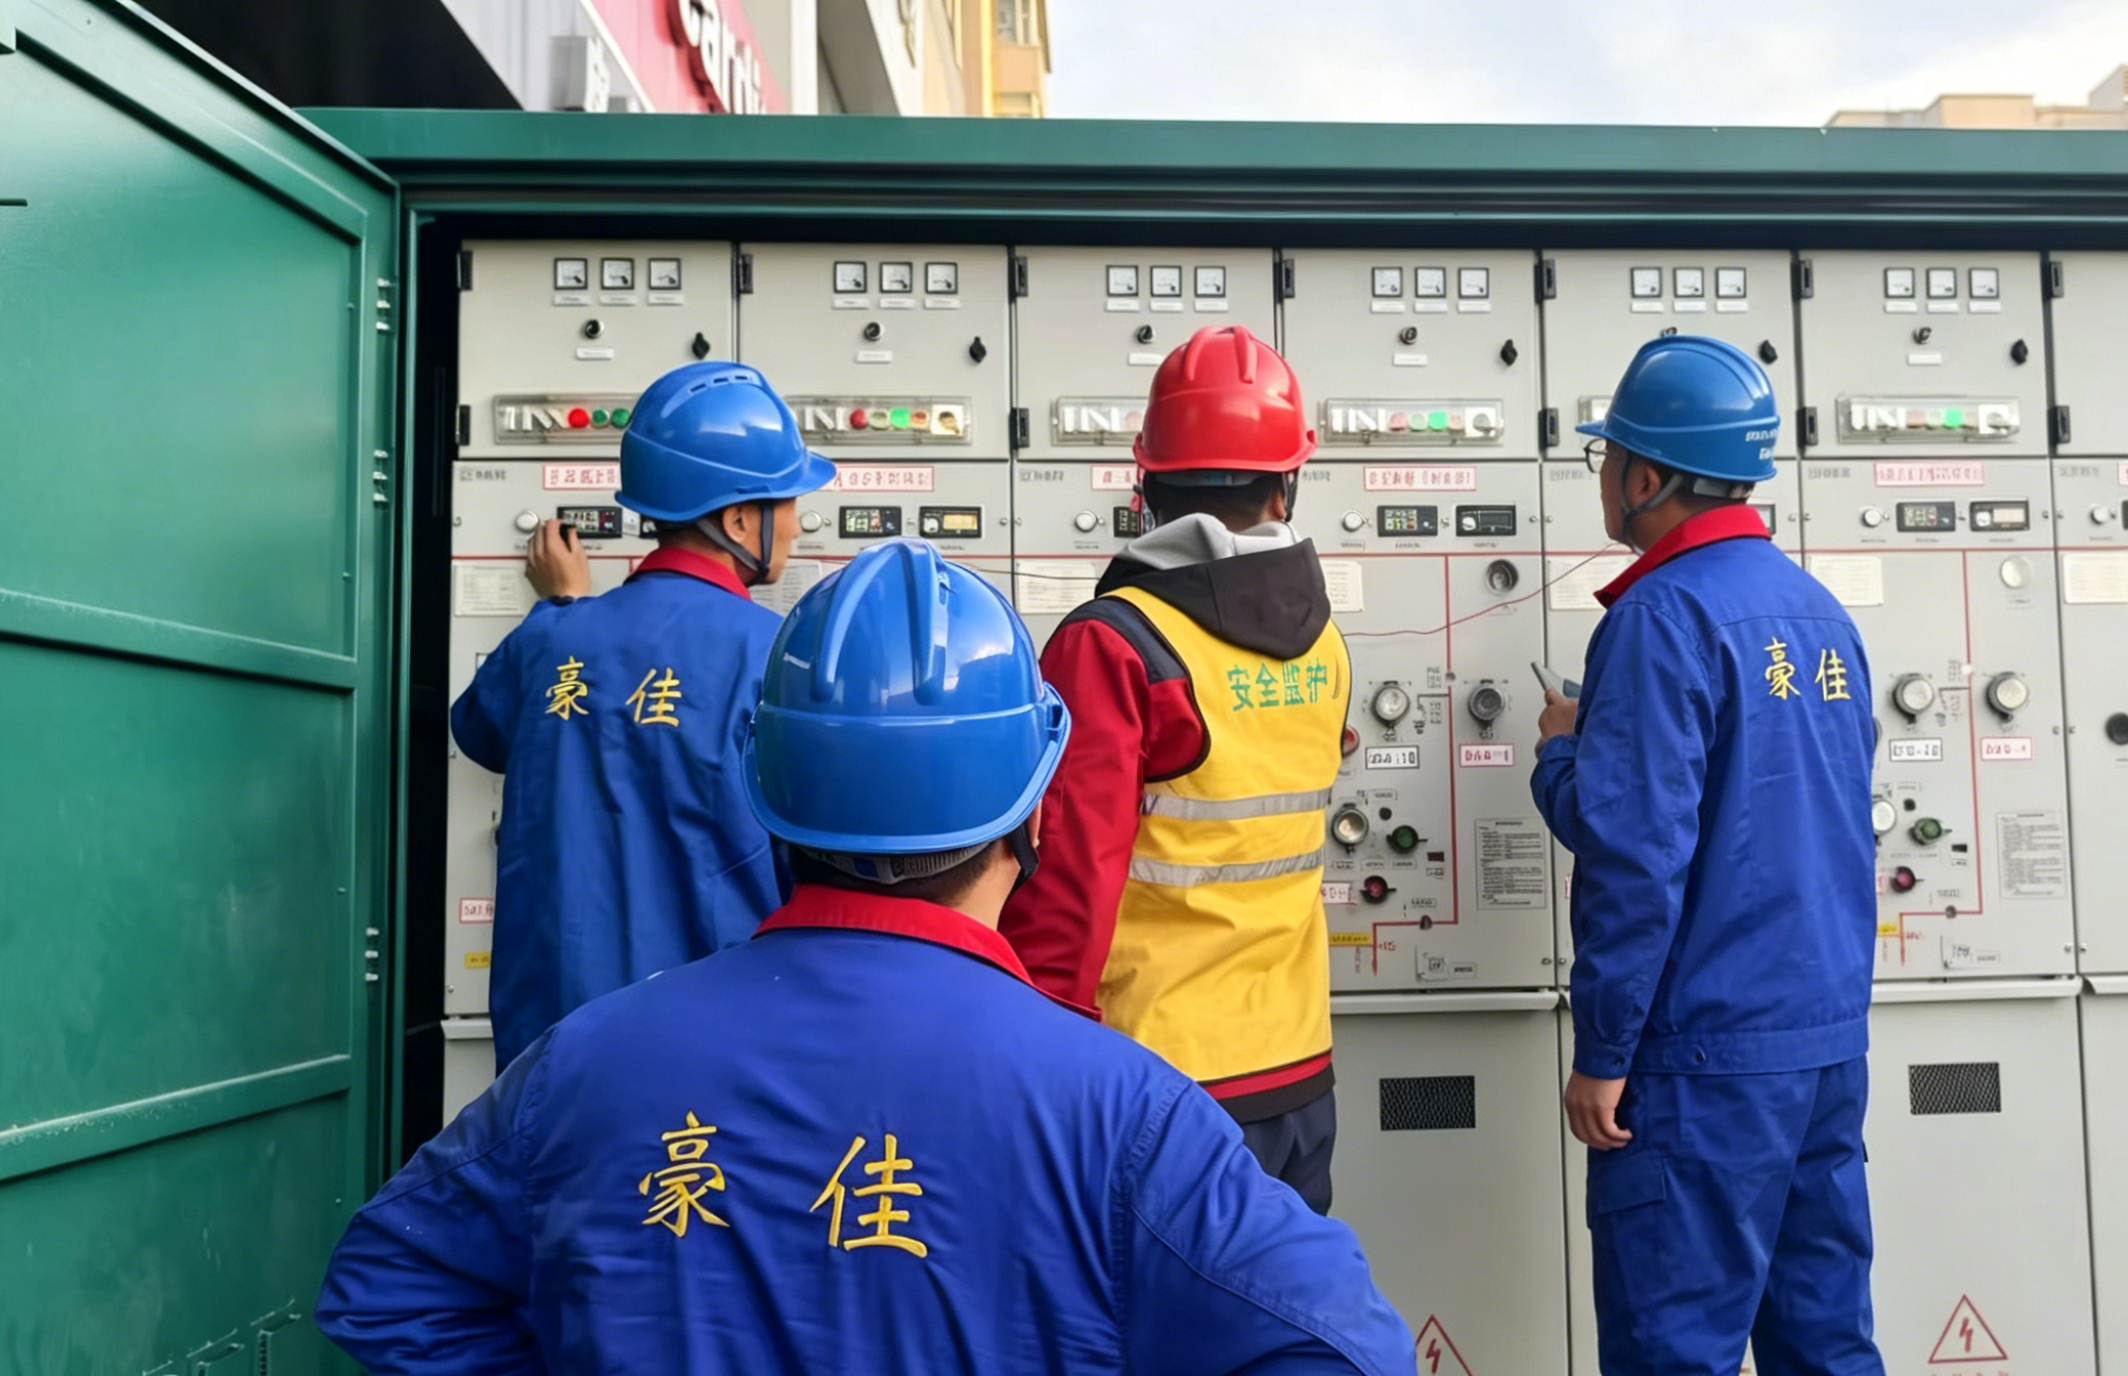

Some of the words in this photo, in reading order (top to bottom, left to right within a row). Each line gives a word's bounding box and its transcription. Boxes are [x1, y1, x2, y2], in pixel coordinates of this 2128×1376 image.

[545, 655, 682, 727] 豪佳
[1226, 657, 1327, 711] 安全监护
[1763, 636, 1851, 702] 豪佳
[638, 1110, 928, 1259] 豪佳
